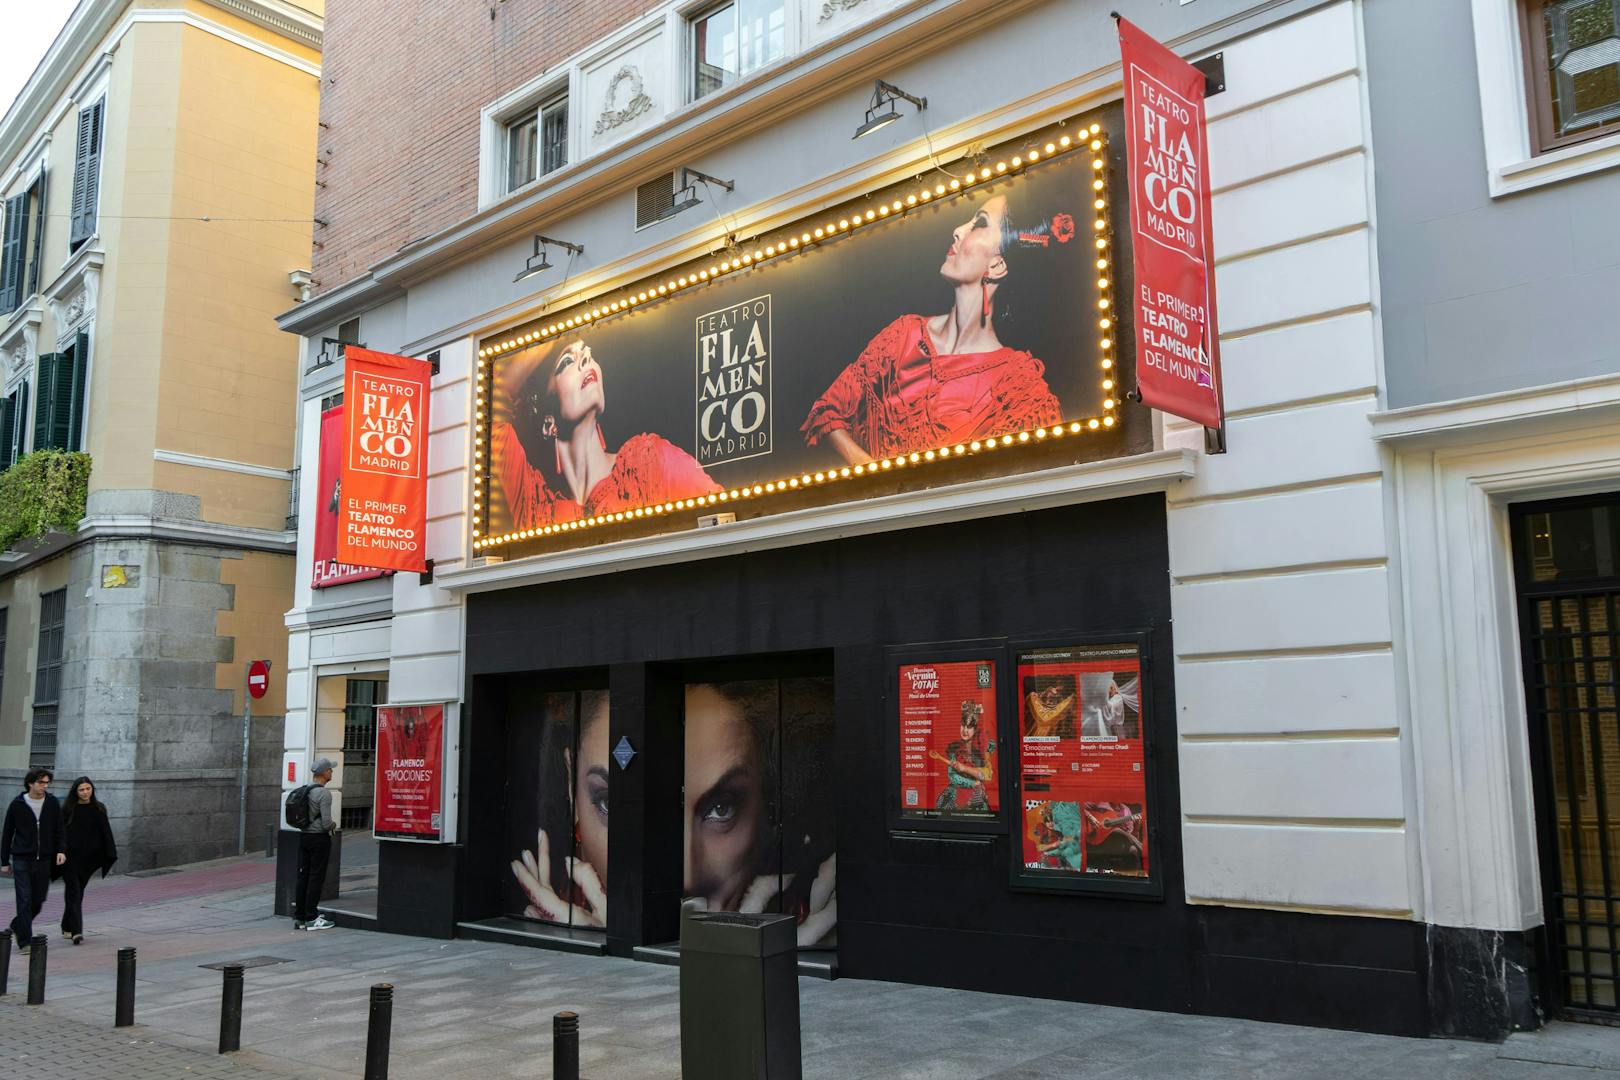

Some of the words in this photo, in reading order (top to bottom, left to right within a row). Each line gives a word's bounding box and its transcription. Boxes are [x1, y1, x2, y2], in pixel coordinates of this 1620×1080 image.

[1140, 81, 1190, 125] TEATRO
[1141, 104, 1197, 168] FLA
[1144, 145, 1197, 190] MEN
[1144, 172, 1196, 224] CO
[1147, 211, 1196, 249] MADRID
[1141, 284, 1155, 305] EL
[1157, 291, 1198, 323] PRIMER
[699, 302, 766, 334] TEATRO
[1141, 306, 1188, 339] TEATRO
[700, 320, 767, 374] FLA
[699, 360, 766, 401] MEN
[1145, 350, 1168, 373] DEL
[1170, 360, 1204, 385] MUN
[362, 379, 414, 397] TEATRO
[362, 393, 415, 423] FLA
[701, 391, 766, 442] CO
[360, 417, 415, 437] MEN
[359, 431, 412, 458] CO
[701, 432, 767, 459] MADRID
[360, 455, 410, 471] MADRID
[348, 499, 362, 510] EL
[365, 499, 407, 514] PRIMER
[348, 511, 394, 525] TEATRO
[348, 523, 415, 539] FLAMENCO
[348, 536, 369, 548] DEL
[371, 538, 418, 551] MUNDO
[313, 559, 386, 582] FLAME
[912, 680, 939, 693] POTAJE
[384, 769, 433, 782] "EMOCIONES"
[392, 759, 425, 768] FLAMENCO
